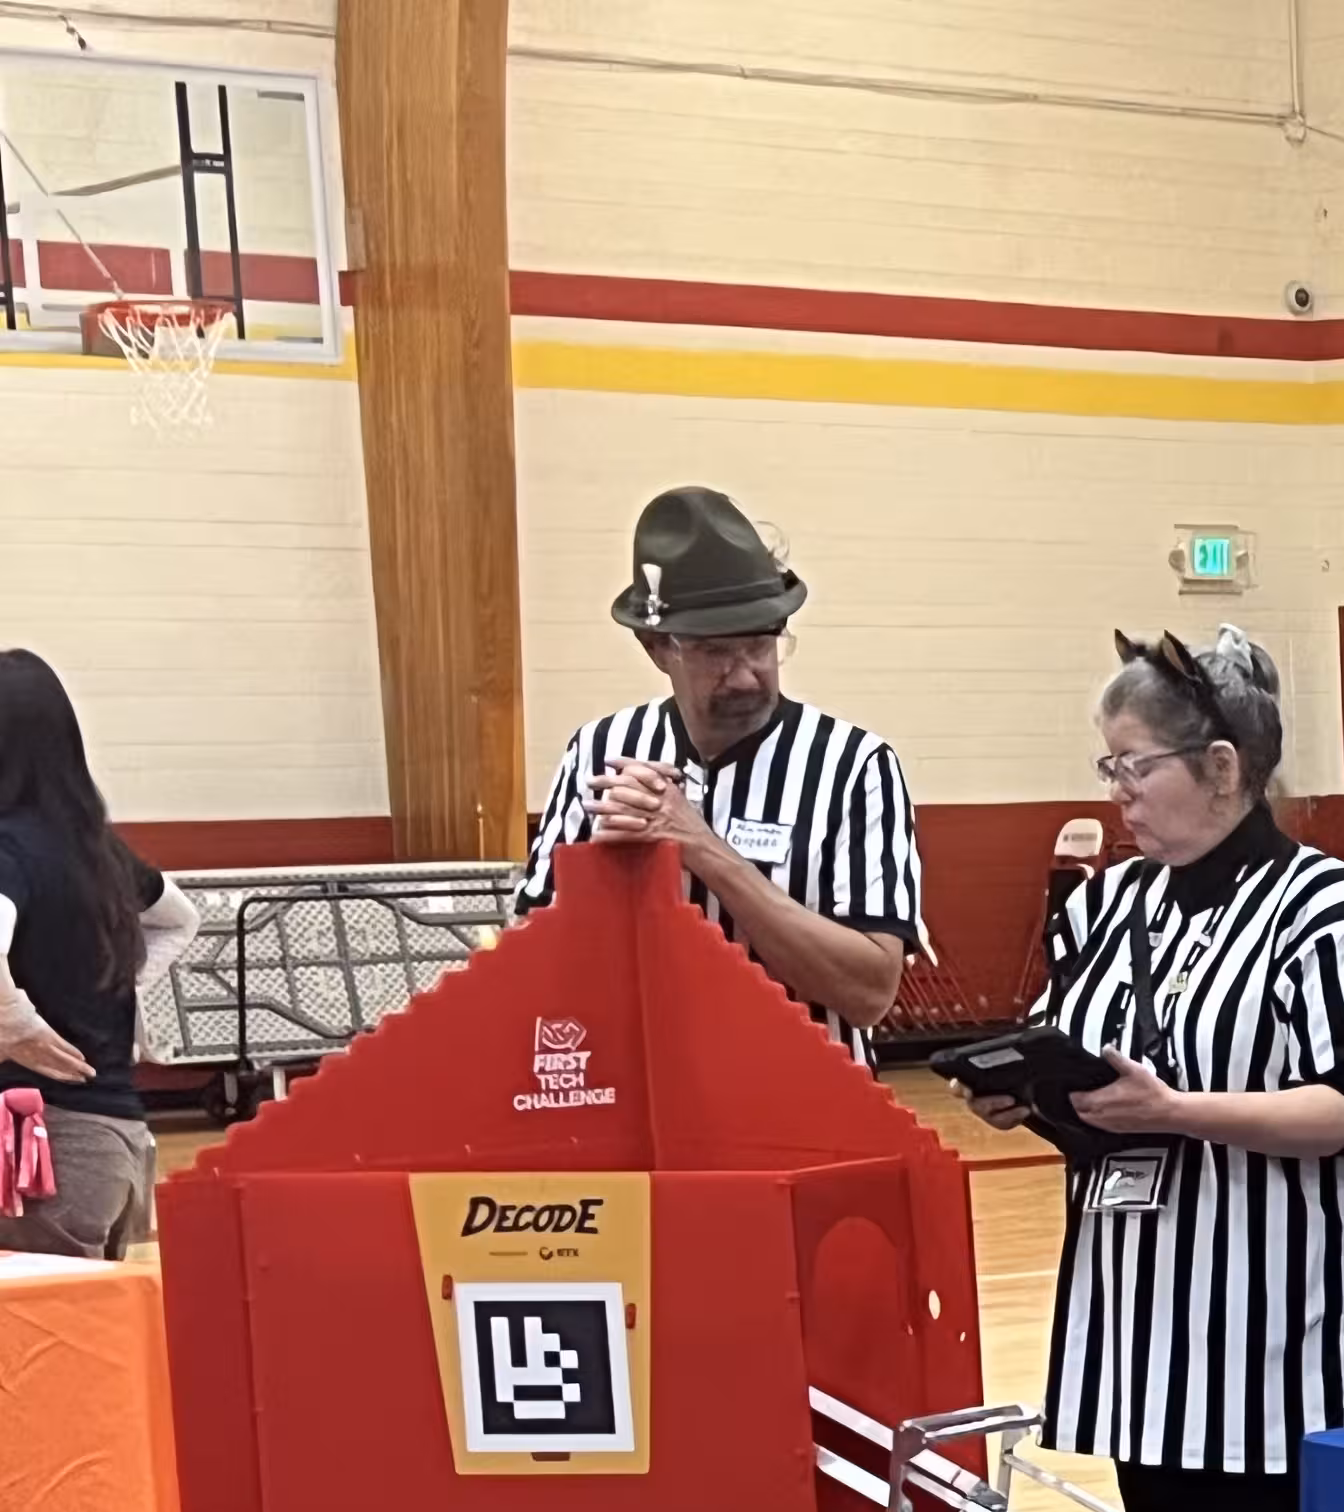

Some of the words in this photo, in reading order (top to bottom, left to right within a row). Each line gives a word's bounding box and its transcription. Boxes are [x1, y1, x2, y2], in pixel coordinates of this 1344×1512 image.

[533, 1051, 592, 1073] FIRST
[535, 1071, 585, 1091] TECH
[512, 1086, 617, 1111] CHALLENGE
[460, 1195, 604, 1238] DECODE
